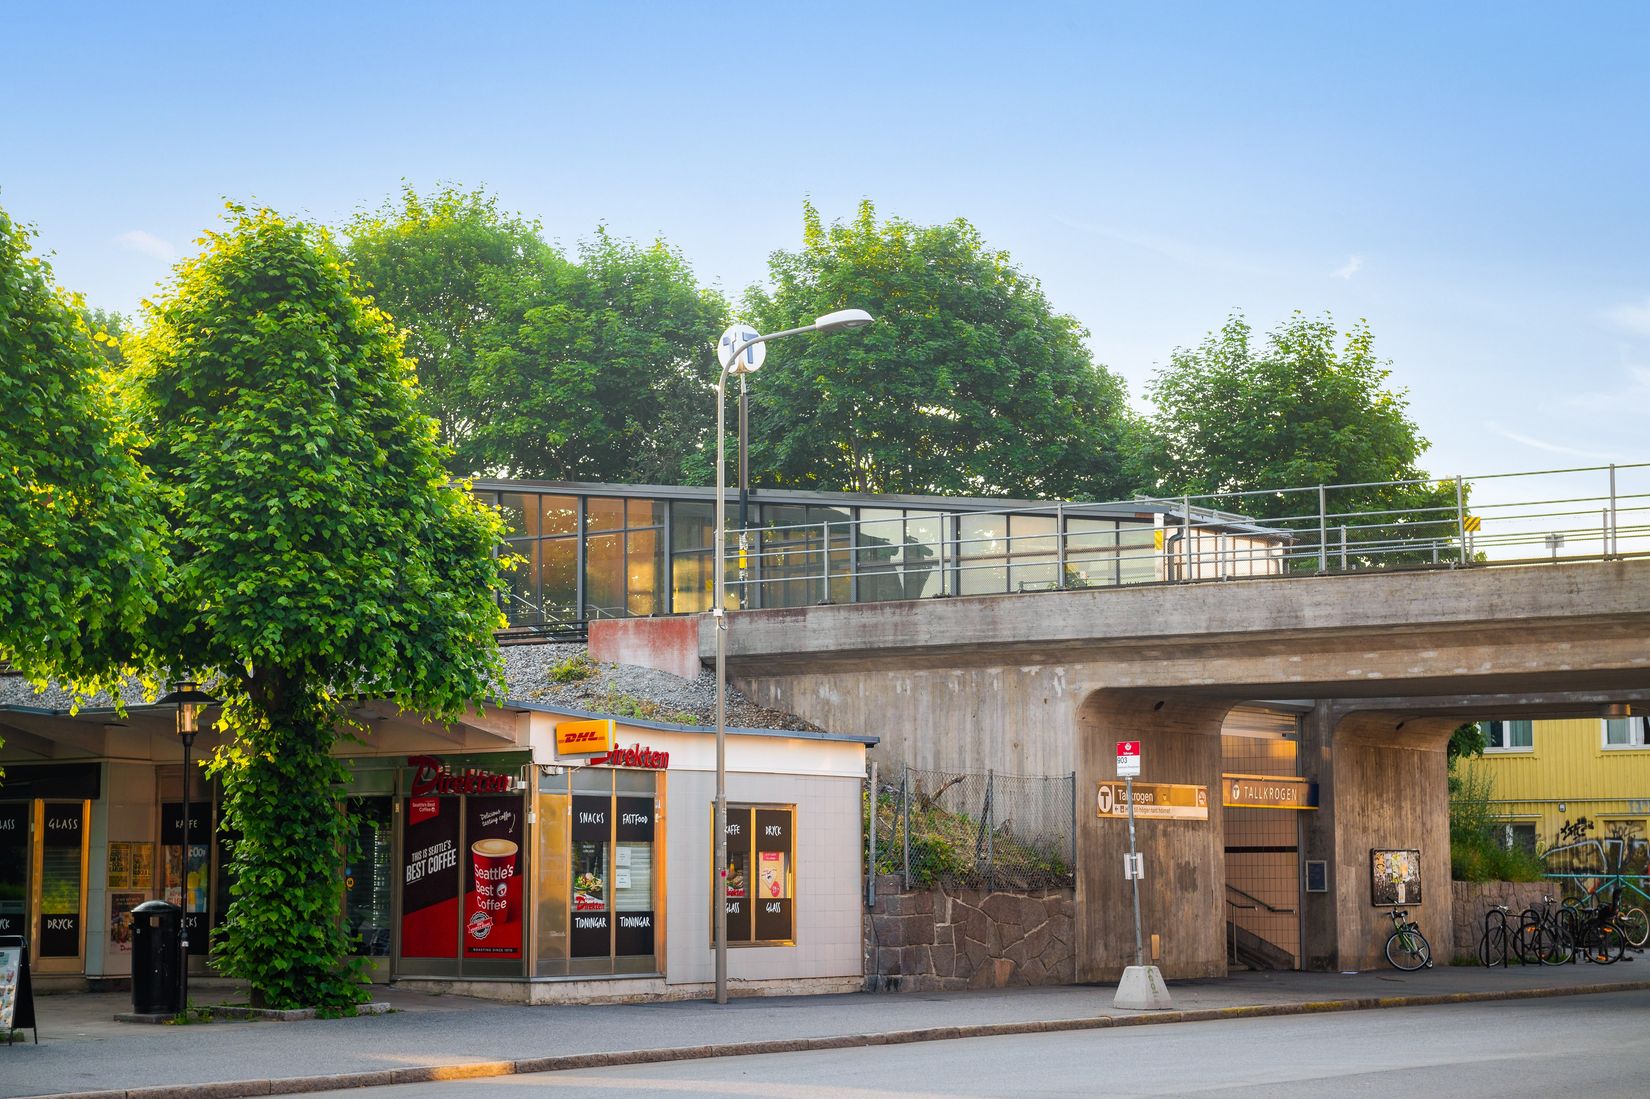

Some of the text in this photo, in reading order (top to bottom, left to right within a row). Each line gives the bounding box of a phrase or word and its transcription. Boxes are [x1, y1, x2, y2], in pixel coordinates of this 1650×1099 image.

[564, 731, 598, 743] DHL
[590, 742, 670, 769] irekten
[1117, 756, 1128, 764] 903
[408, 755, 509, 796] Direkten
[1244, 786, 1297, 801] TALLKROGEN
[1100, 791, 1110, 810] T
[0, 818, 15, 830] LASS
[48, 818, 78, 830] GLASS
[175, 819, 198, 829] KAFE
[579, 812, 605, 824] SNACKS
[765, 825, 782, 836] DRYCK
[411, 839, 452, 863] THIS IS SEATTLE'S
[406, 848, 457, 882] BEST COFFEE
[474, 863, 514, 880] Seattle's
[475, 880, 494, 897] Best
[476, 896, 507, 911] Coffee
[765, 902, 781, 913] GLASS
[47, 918, 74, 930] DRYCK
[575, 917, 607, 929] TIDNINGAR
[620, 916, 651, 928] TIDNINGAR
